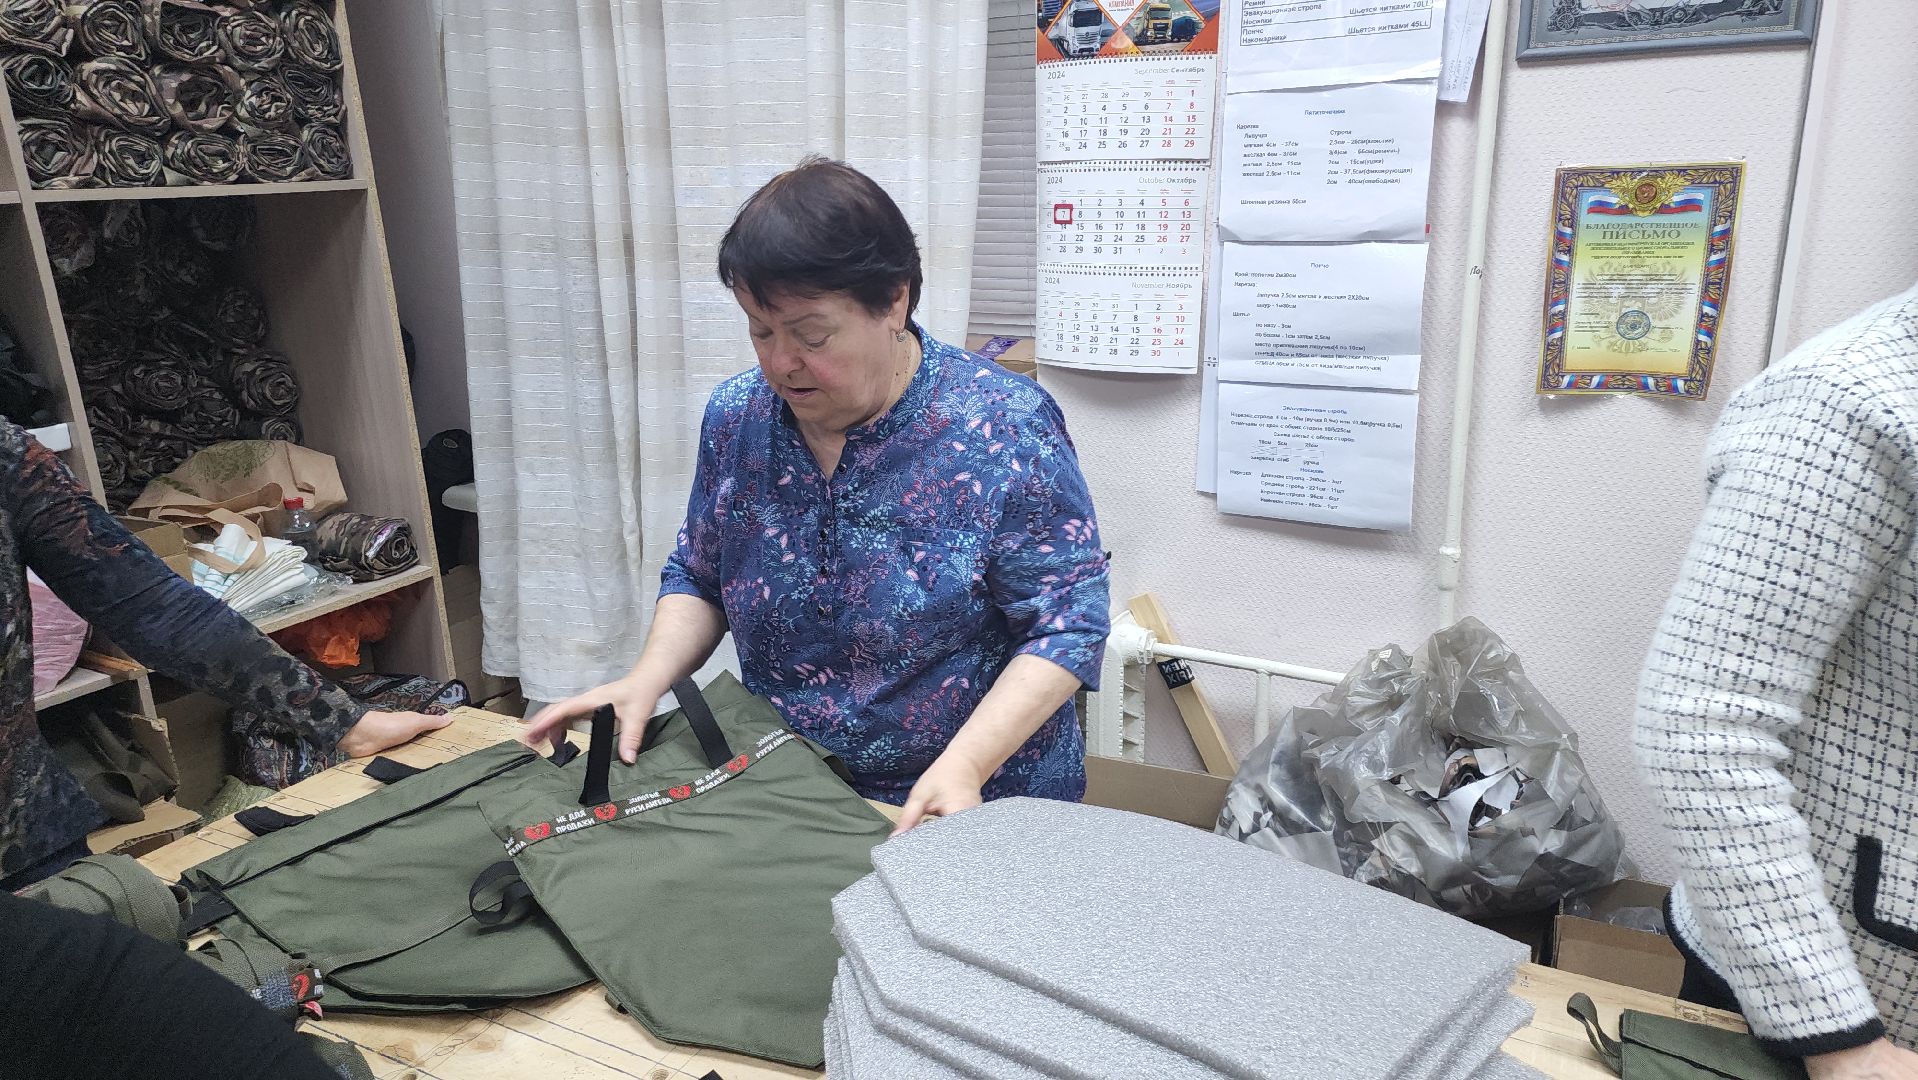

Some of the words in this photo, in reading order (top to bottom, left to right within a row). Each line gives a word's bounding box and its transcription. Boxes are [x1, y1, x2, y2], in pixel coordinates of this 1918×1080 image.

[1048, 71, 1065, 79] 2024
[1047, 176, 1063, 184] 2024
[1602, 230, 1681, 239] ПИСЬМО
[756, 728, 785, 747] ЗОЛОТЫ
[755, 744, 774, 758] РУКИ
[695, 778, 705, 786] НЕ
[705, 768, 722, 781] ДЛЯ
[696, 773, 731, 794] ПРОДАЖИ
[627, 791, 660, 804] ЗОЛОТЫЕ
[625, 805, 646, 815] РУКИ
[646, 797, 673, 809] АНГЕЛА
[556, 815, 567, 823] НЕ
[568, 809, 586, 820] ДЛЯ
[555, 818, 595, 834] ПРОДАЖИ
